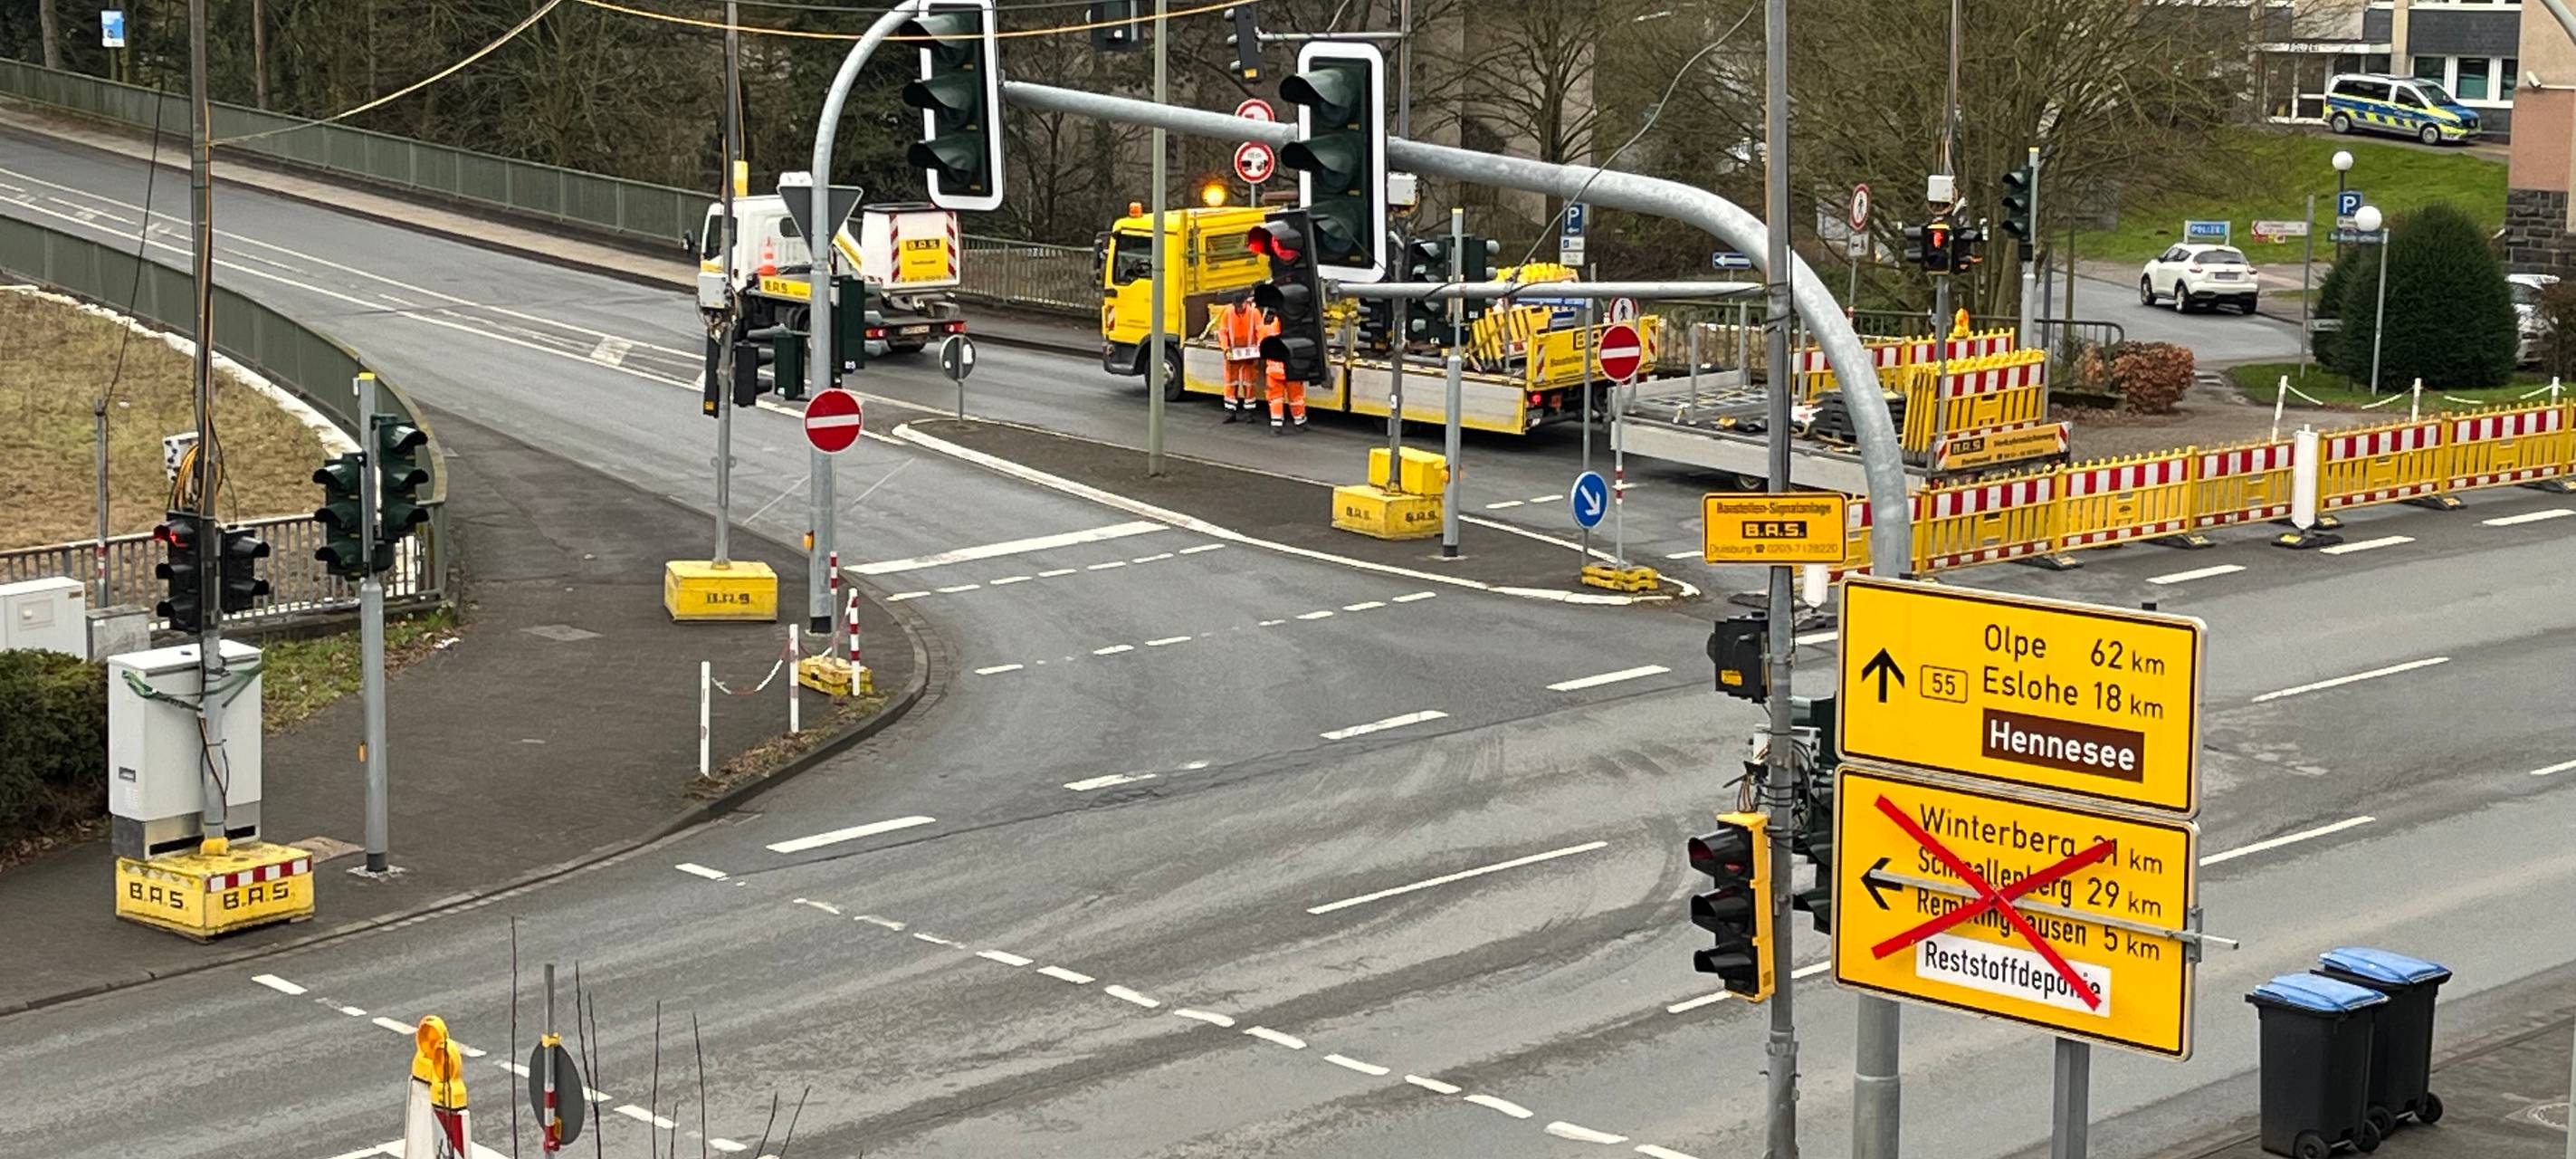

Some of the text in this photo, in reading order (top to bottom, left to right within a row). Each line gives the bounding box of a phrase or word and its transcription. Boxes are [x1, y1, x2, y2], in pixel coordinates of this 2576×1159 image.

[1567, 206, 1579, 225] P
[2342, 196, 2357, 214] P
[1744, 522, 1805, 537] B.A.S.
[1709, 543, 1753, 555] Duisburg
[1984, 623, 2165, 675] Olpe 62 km
[1932, 673, 1956, 695] 55
[1983, 665, 2163, 720] Eslohe 18 km
[1990, 719, 2136, 771] Hennesee
[1920, 803, 2075, 859] Winterberg
[2130, 848, 2163, 875] km
[2087, 876, 2120, 909] 29
[2128, 891, 2161, 918] km
[2103, 924, 2119, 952] 5
[2126, 934, 2161, 962] km
